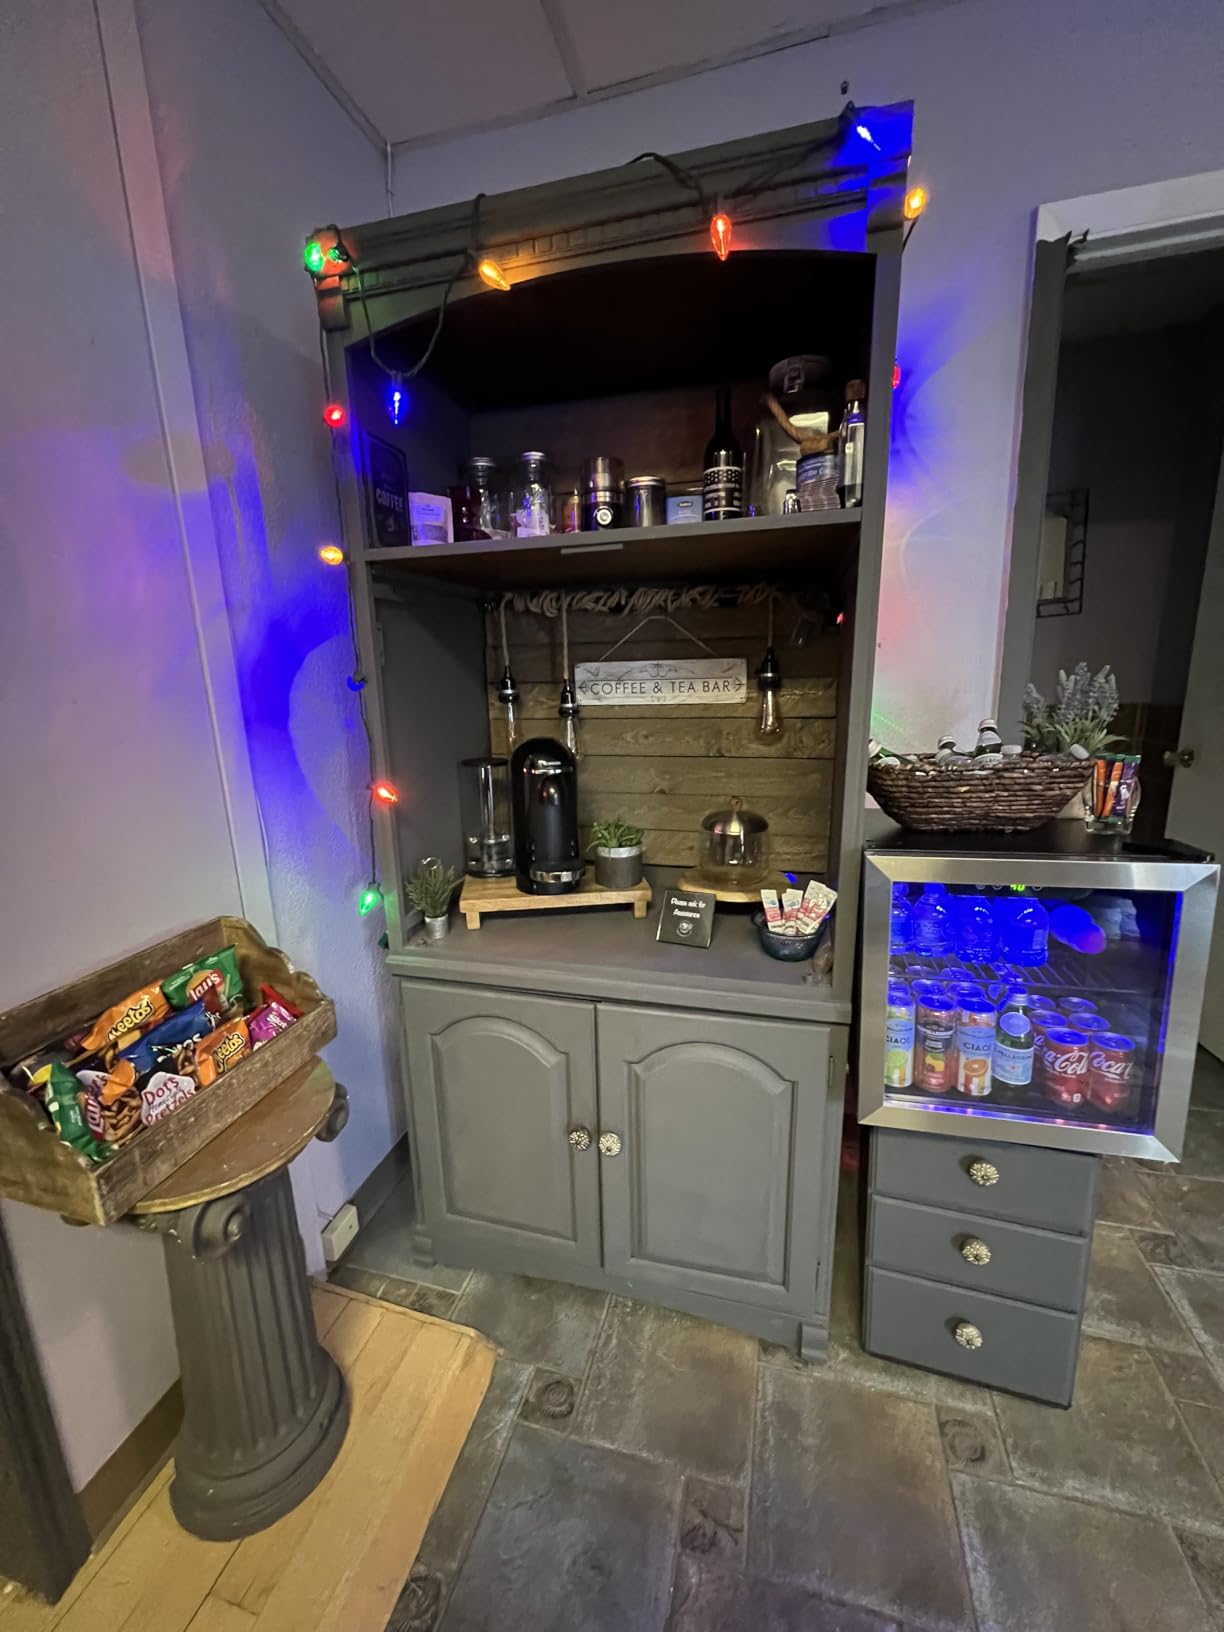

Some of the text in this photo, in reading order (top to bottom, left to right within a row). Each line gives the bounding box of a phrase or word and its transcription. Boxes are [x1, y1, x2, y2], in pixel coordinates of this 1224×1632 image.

[590, 680, 731, 695] COFFEE & TEA BAR
[145, 1088, 195, 1126] Pretzels
